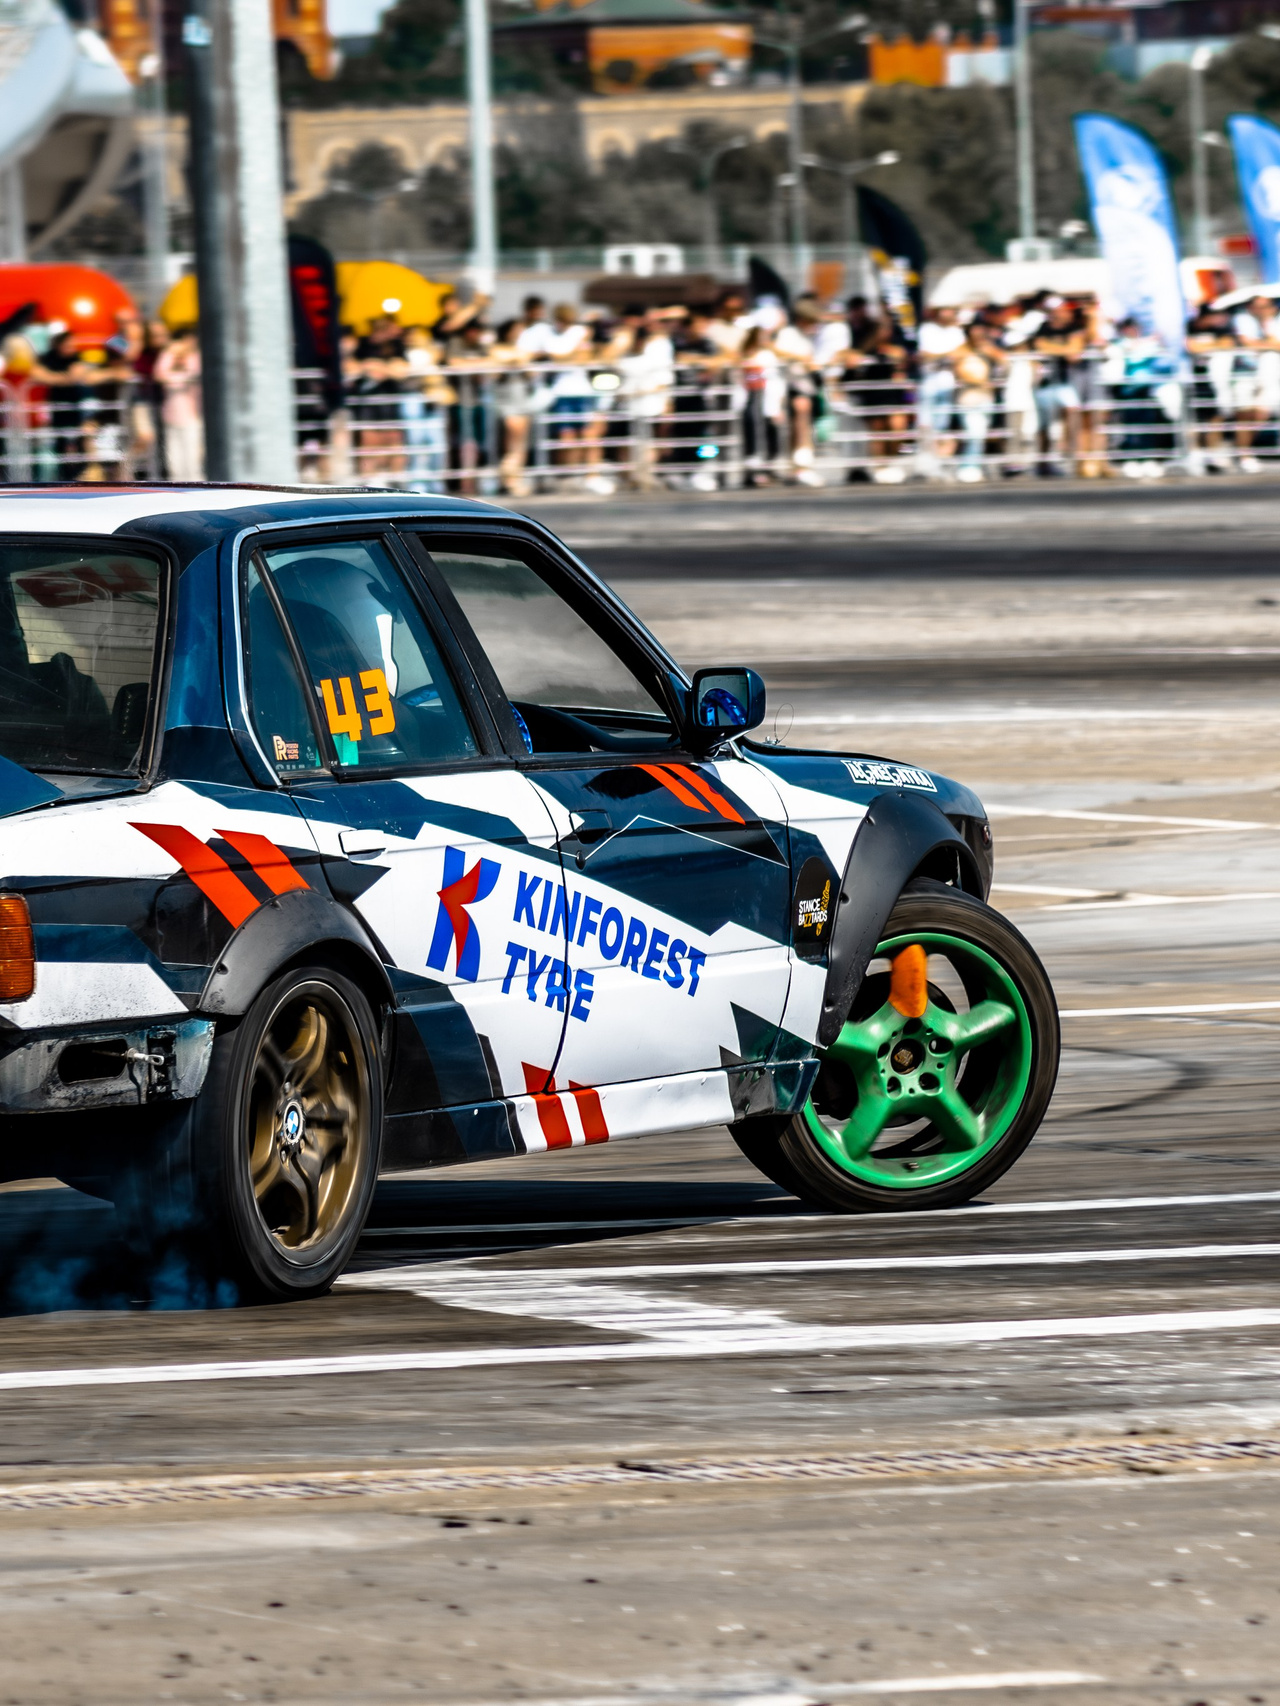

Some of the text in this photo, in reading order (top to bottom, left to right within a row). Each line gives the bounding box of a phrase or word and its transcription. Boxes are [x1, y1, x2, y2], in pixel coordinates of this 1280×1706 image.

[320, 668, 396, 742] 43
[513, 870, 707, 998] KINFOREST
[798, 898, 821, 914] STANCE
[798, 910, 828, 928] BAZZTARDS
[501, 940, 595, 1023] TYRE
